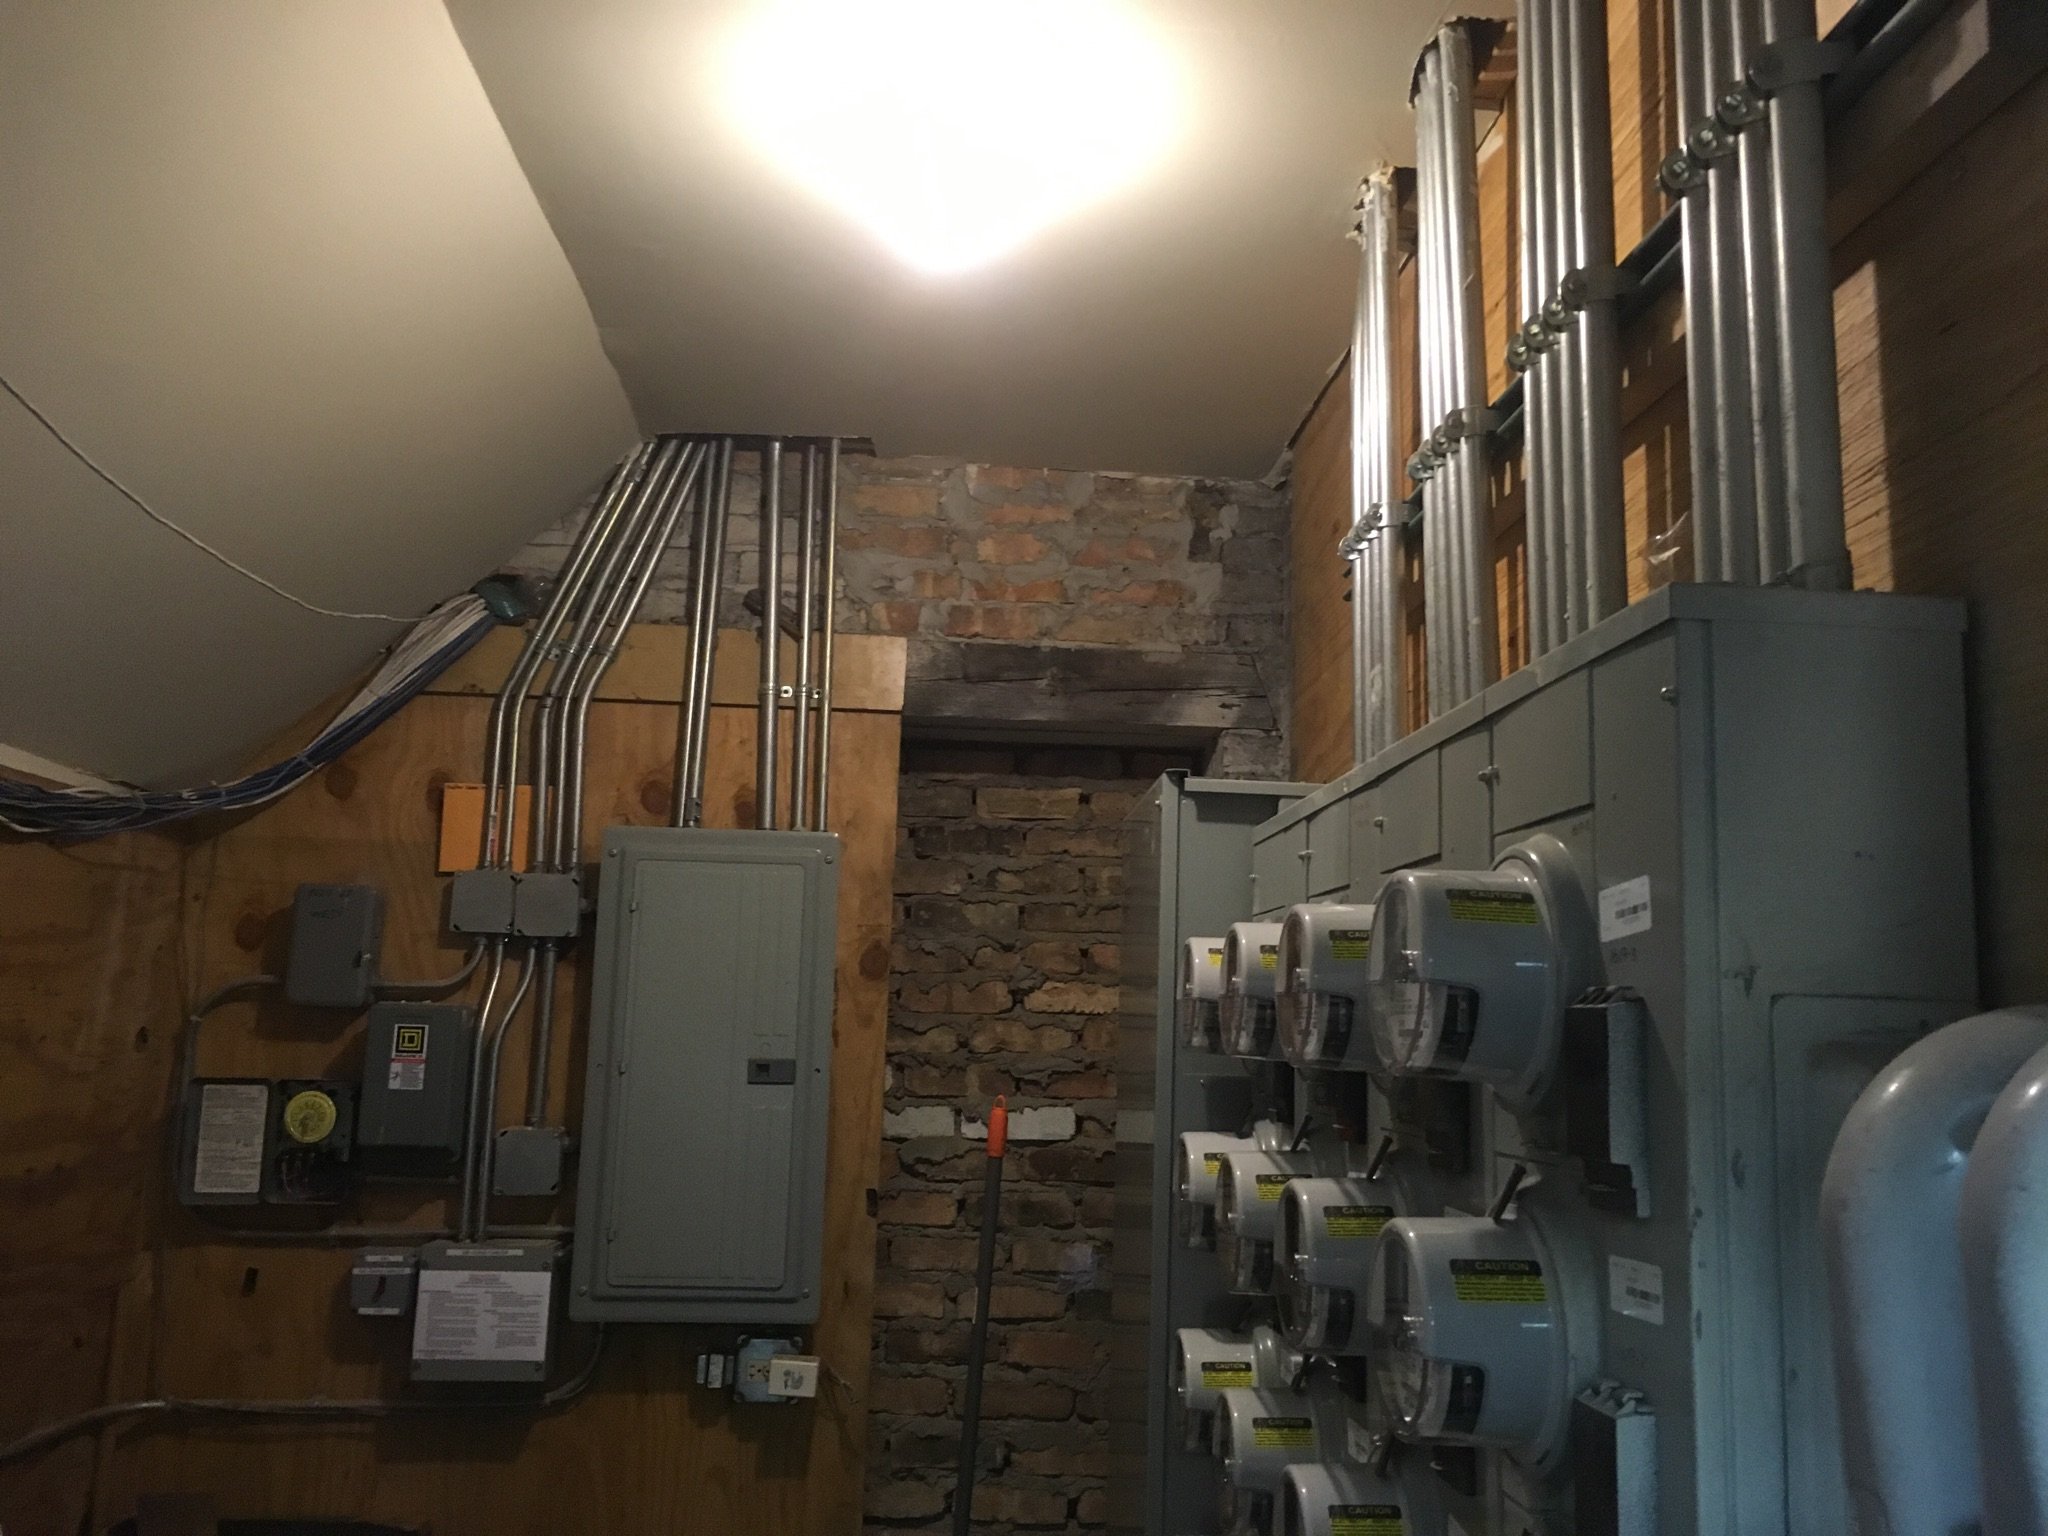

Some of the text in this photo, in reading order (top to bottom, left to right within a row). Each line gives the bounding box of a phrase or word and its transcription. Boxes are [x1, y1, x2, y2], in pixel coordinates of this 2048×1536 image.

[1469, 890, 1522, 900] CAUTION
[1342, 1206, 1385, 1215] CAUTION
[1475, 1260, 1529, 1271] CAUTION
[1215, 1362, 1246, 1370] CAUTION
[1347, 1505, 1393, 1514] CAUTION
